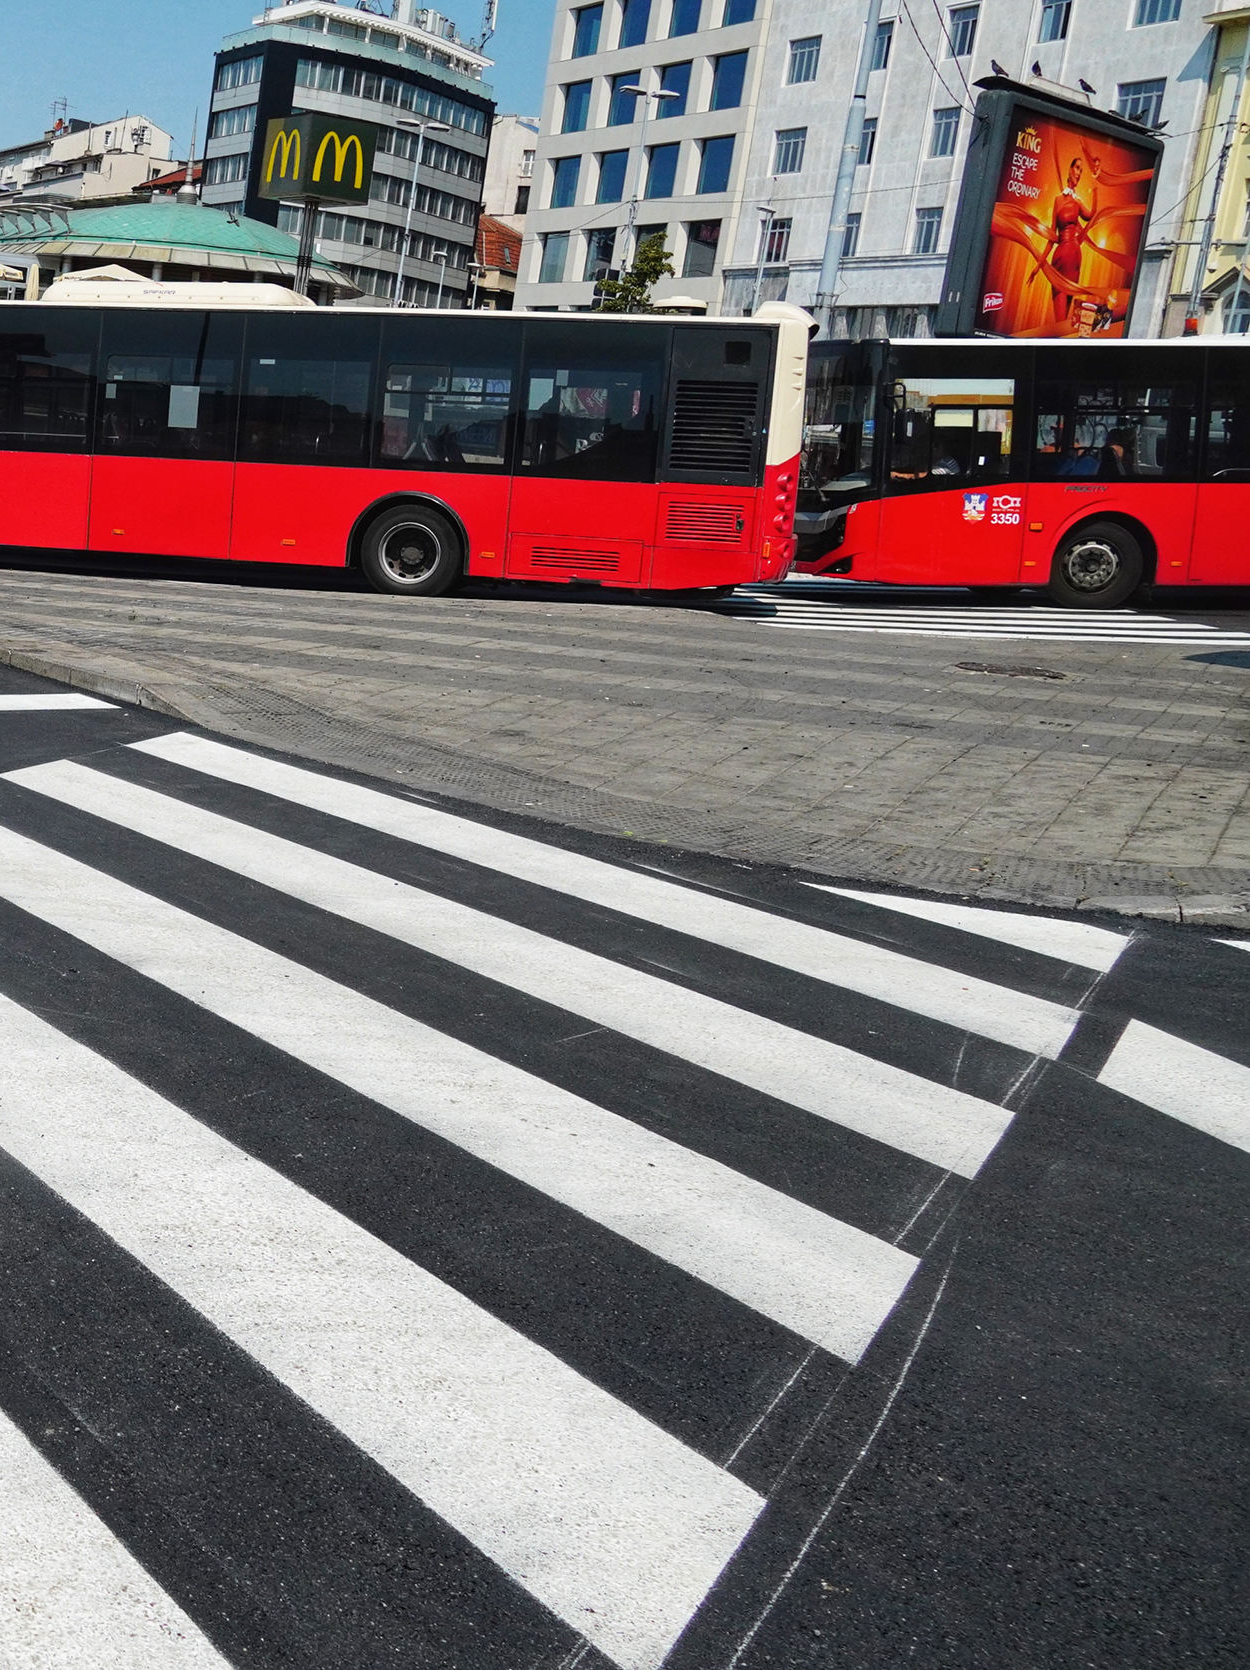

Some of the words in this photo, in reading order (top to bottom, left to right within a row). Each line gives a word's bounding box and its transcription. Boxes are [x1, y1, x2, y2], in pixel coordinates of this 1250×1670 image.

[1016, 132, 1042, 153] KING
[1012, 153, 1038, 171] ESCAPE
[1011, 166, 1025, 180] THE
[1007, 180, 1041, 199] ORDINARY
[990, 513, 1020, 525] 3350
